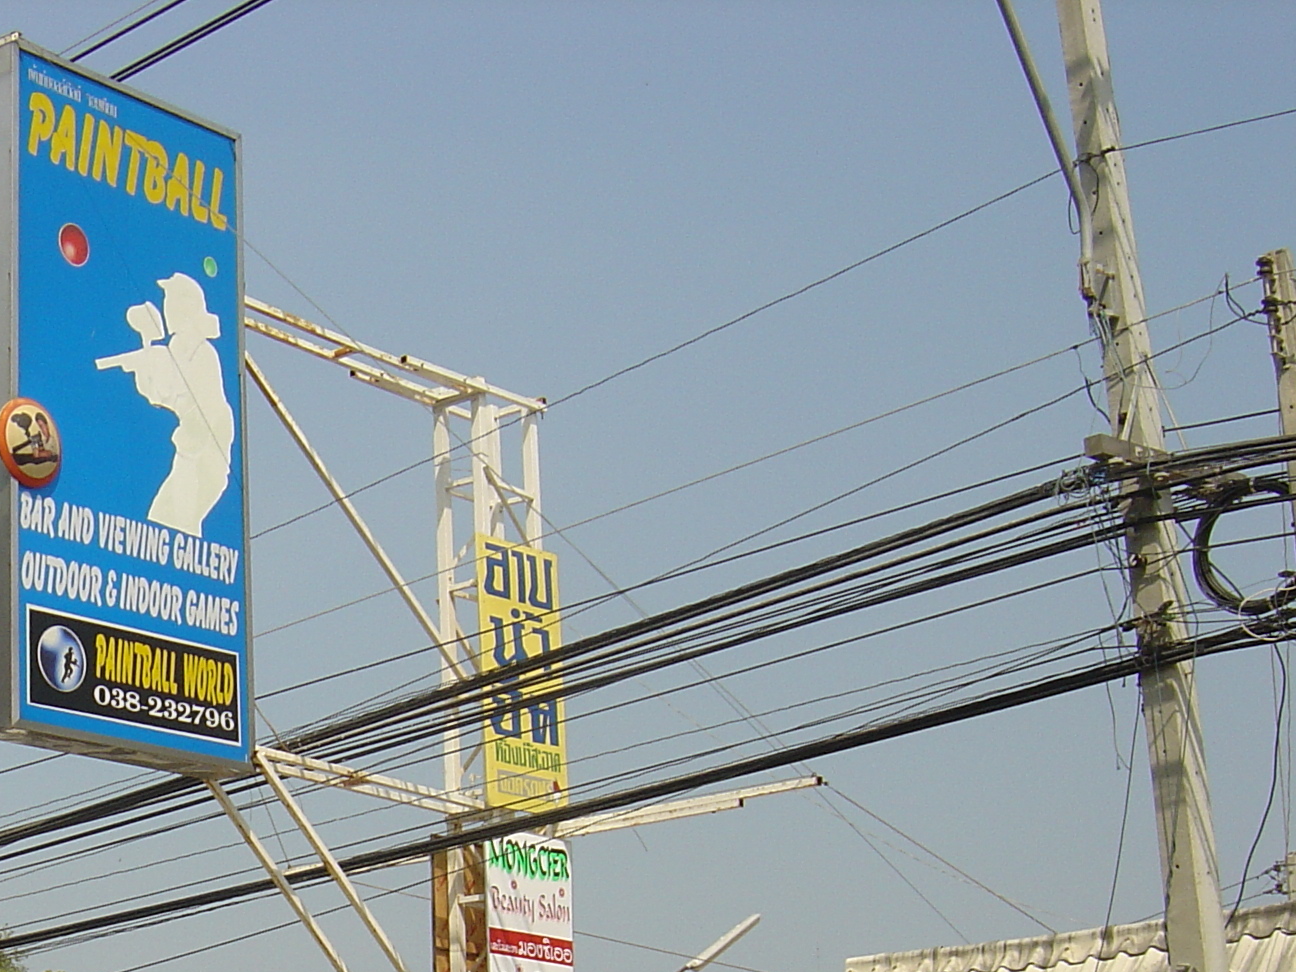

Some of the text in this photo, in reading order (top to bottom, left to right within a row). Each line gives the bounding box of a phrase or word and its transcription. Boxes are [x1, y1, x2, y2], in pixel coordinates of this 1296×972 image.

[27, 92, 227, 231] PAINTBALL
[20, 492, 239, 584] BAR AND VIEWING GALLERY
[21, 551, 239, 636] OUTDOOR & INDOOR GAMES
[94, 685, 235, 731] 038-232796
[95, 634, 235, 706] PAINTBALL WORLD
[491, 885, 571, 924] Beauty Salon
